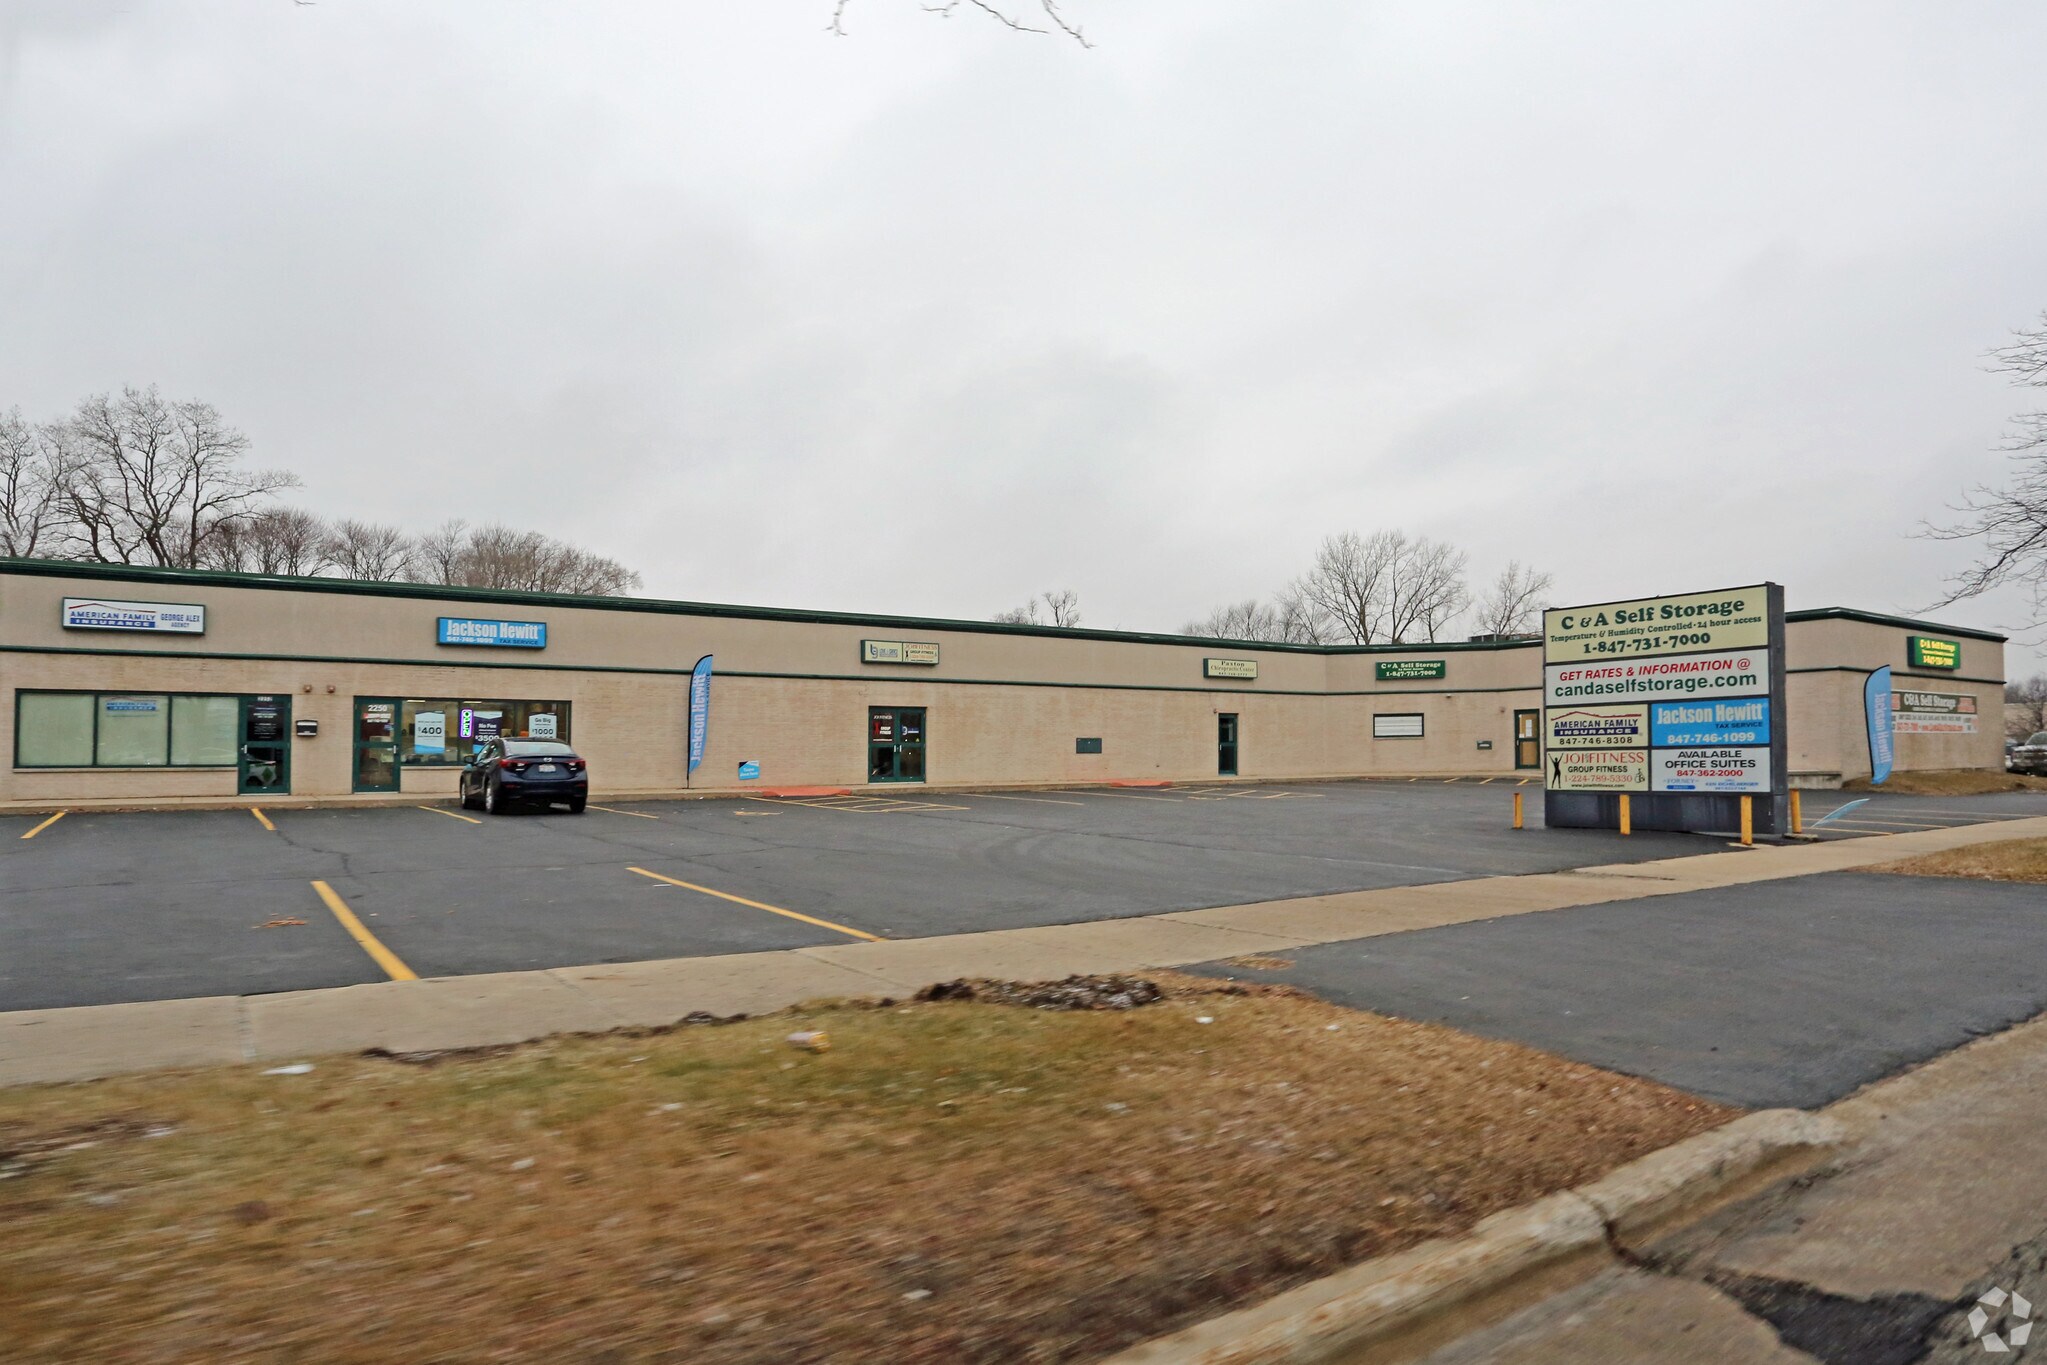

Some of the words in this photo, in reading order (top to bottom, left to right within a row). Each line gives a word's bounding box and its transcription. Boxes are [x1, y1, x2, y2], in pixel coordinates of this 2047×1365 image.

[70, 611, 119, 619] AMERICAN
[123, 613, 156, 621] FAMILY
[160, 613, 184, 622] GEORGE
[1561, 616, 1574, 630] C
[1580, 617, 1592, 628] &
[1594, 612, 1609, 627] A
[1615, 607, 1655, 625] Self
[1660, 600, 1745, 620] Storage
[75, 618, 150, 627] INSURANCE
[447, 620, 497, 637] Jackson
[500, 623, 539, 639] Hewitt
[1550, 633, 1598, 643] Temperature
[1607, 627, 1645, 637] Humidity
[1709, 619, 1732, 627] hour
[1733, 616, 1762, 625] access
[1583, 632, 1711, 654] 1-847-731-7000
[1560, 670, 1582, 681] GET
[1585, 667, 1623, 679] RATES
[1626, 666, 1635, 676] &
[1638, 659, 1733, 675] INFORMATION
[1736, 657, 1751, 671] @
[1554, 673, 1757, 697] candaselfstorage.com
[1657, 706, 1713, 725] Jackson
[1715, 702, 1763, 722] Hewitt
[1554, 720, 1601, 729] AMERICAN
[1604, 718, 1639, 727] FAMILY
[1731, 721, 1763, 729] SERVICE
[690, 713, 705, 761] Jackson
[1559, 736, 1633, 745] 847-746-8308
[1667, 732, 1755, 744] 847-746-1099
[1678, 750, 1742, 759] AVAILABLE
[1568, 765, 1594, 773] GROUP
[1596, 765, 1628, 773] FITNESS
[1665, 760, 1706, 769] OFFICE
[1711, 759, 1756, 768] SUITES
[1677, 769, 1743, 777] 847-362-2000
